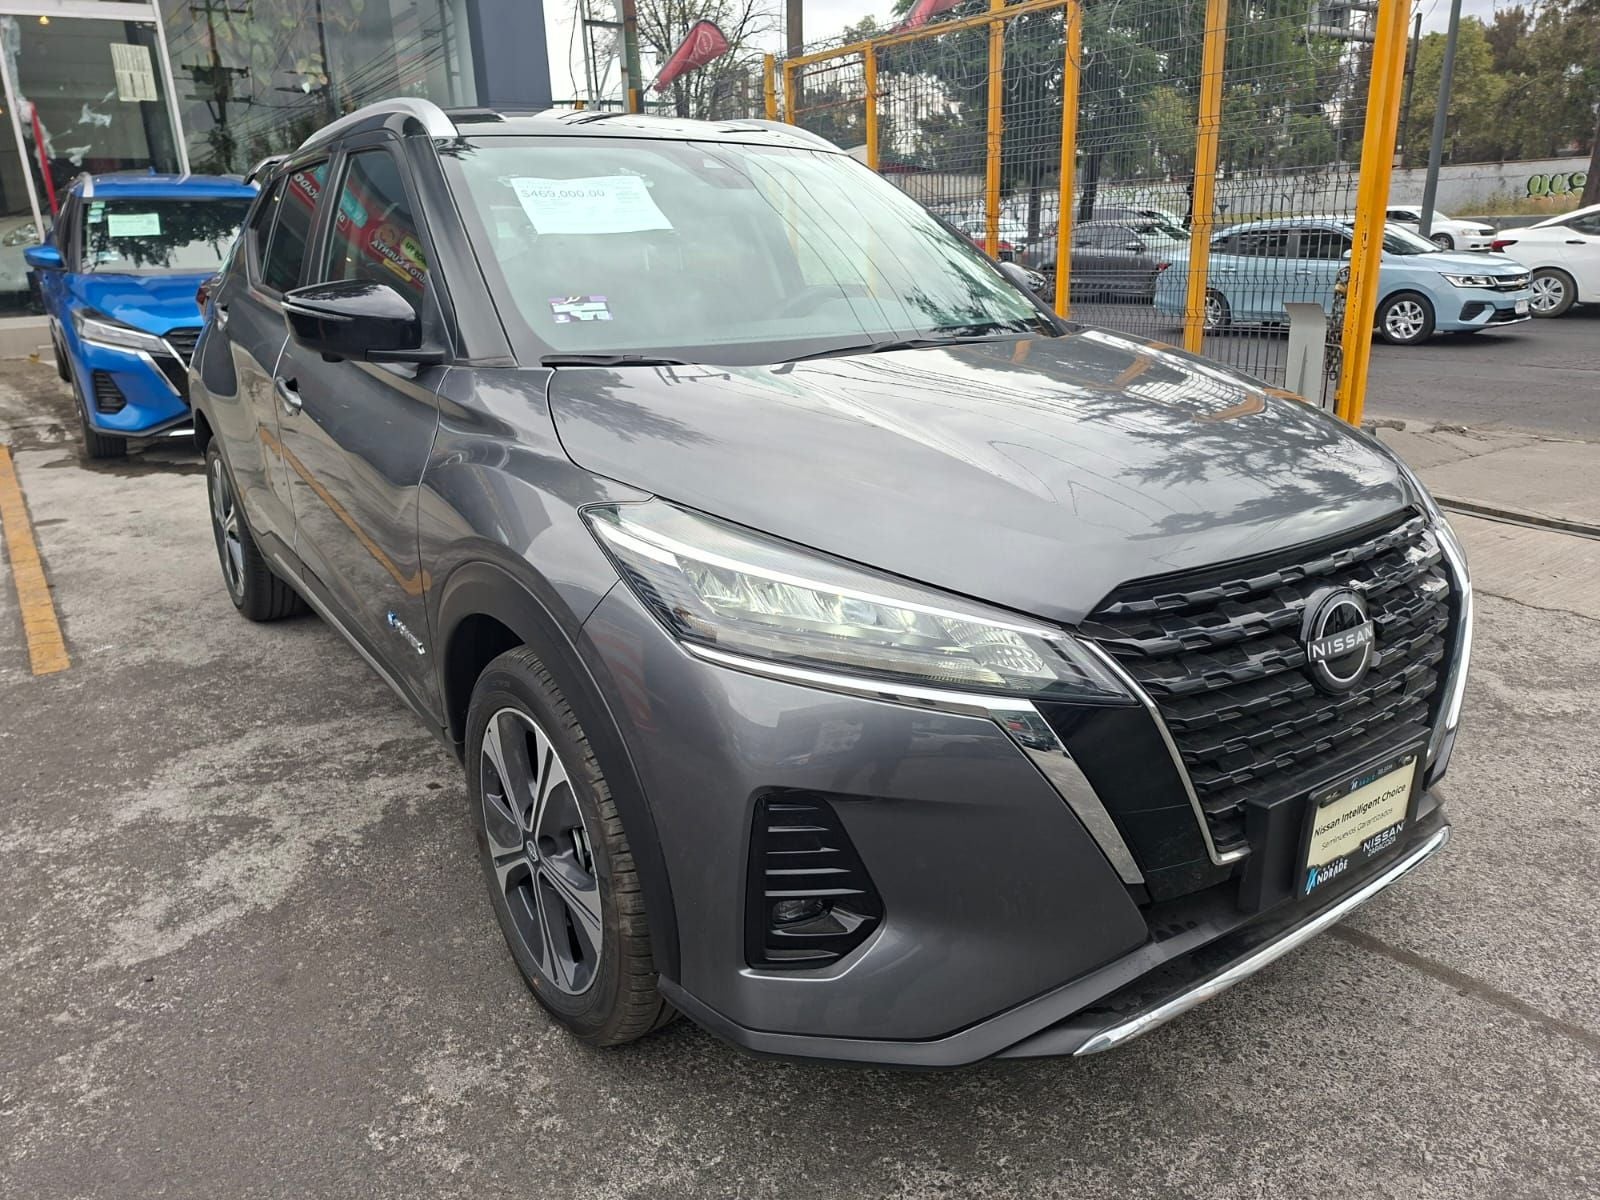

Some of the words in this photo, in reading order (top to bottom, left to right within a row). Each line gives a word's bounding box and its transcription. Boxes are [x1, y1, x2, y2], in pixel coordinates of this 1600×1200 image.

[1312, 623, 1373, 659] NISSAN
[1314, 817, 1341, 838] Nissan
[1342, 795, 1382, 823] Intelligent
[1382, 784, 1406, 802] Choice
[1321, 827, 1357, 851] Seminuevos
[1362, 822, 1405, 852] NISSAN
